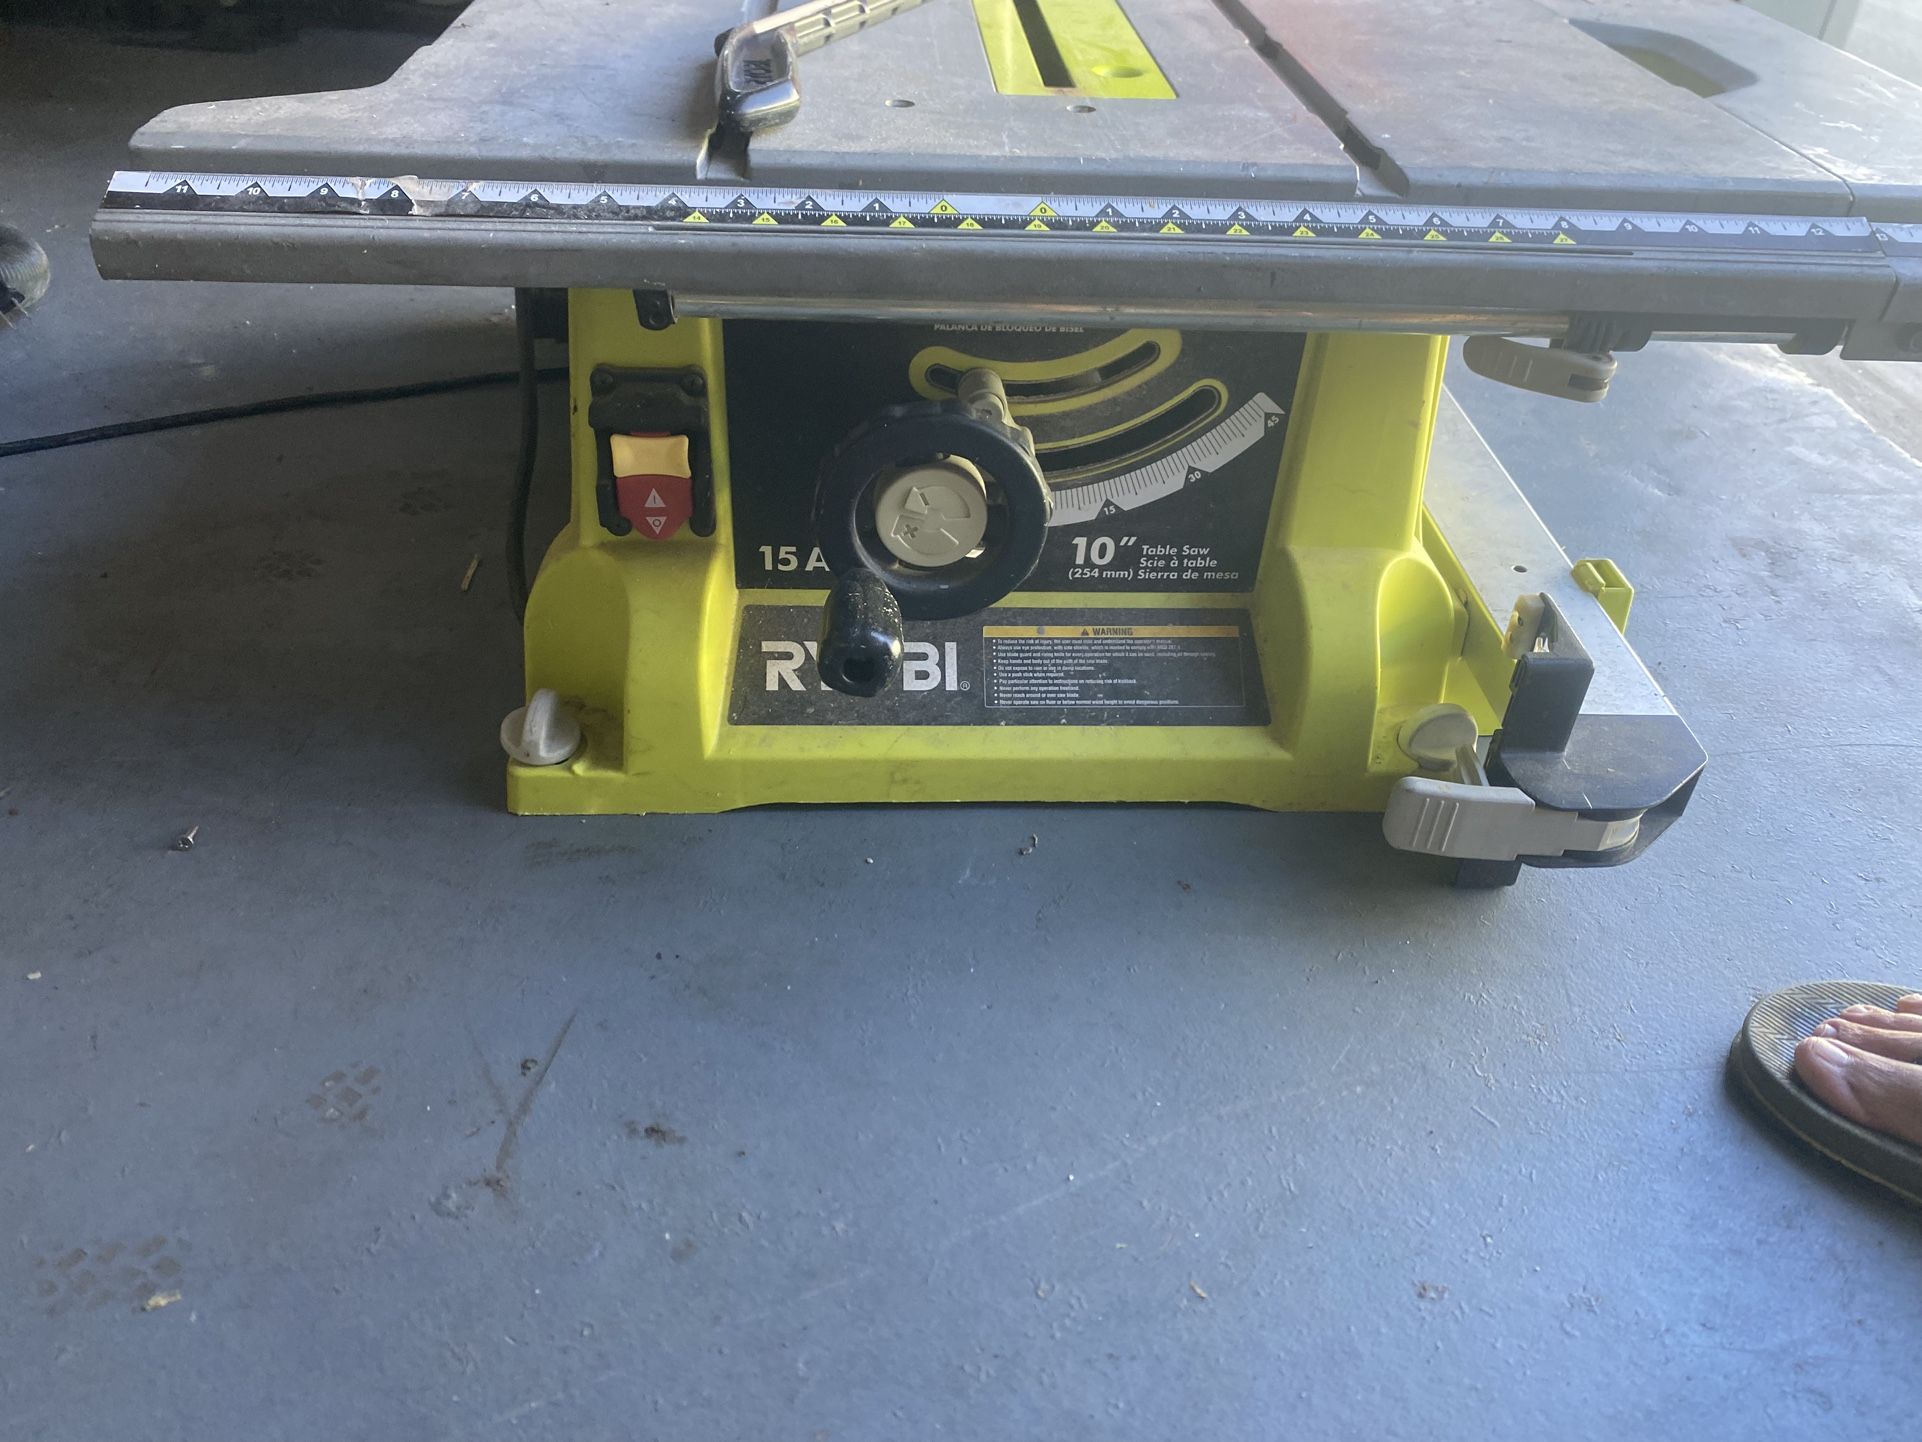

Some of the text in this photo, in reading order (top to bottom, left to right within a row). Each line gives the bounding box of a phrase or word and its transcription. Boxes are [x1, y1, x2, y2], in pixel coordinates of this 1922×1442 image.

[175, 185, 189, 194] 11
[247, 187, 261, 195] 10
[320, 187, 329, 195] 9
[391, 189, 400, 198] 8
[530, 194, 539, 202] 6
[600, 196, 609, 204] 5
[737, 199, 746, 208] 3
[804, 201, 814, 209] 2
[872, 203, 881, 211] 1
[940, 204, 949, 212] 0
[1039, 206, 1048, 214] 0
[1106, 208, 1113, 216] 1
[1171, 210, 1181, 218] 2
[1237, 211, 1246, 220] 3
[1303, 213, 1312, 222] 4
[1368, 215, 1377, 223] 5
[1433, 217, 1442, 226] 6
[1495, 219, 1504, 228] 7
[1266, 415, 1280, 428] 45
[1188, 470, 1202, 483] 30
[1103, 504, 1116, 516] 15
[1071, 536, 1138, 566] 10"
[1142, 545, 1211, 556] Table Saw
[758, 545, 799, 572] 15
[1139, 556, 1218, 568] Scie à table
[1068, 568, 1133, 581] (254 mm)
[1137, 569, 1239, 580] Sierra de mesa
[1092, 627, 1134, 636] WARNING
[761, 640, 958, 691] RBI
